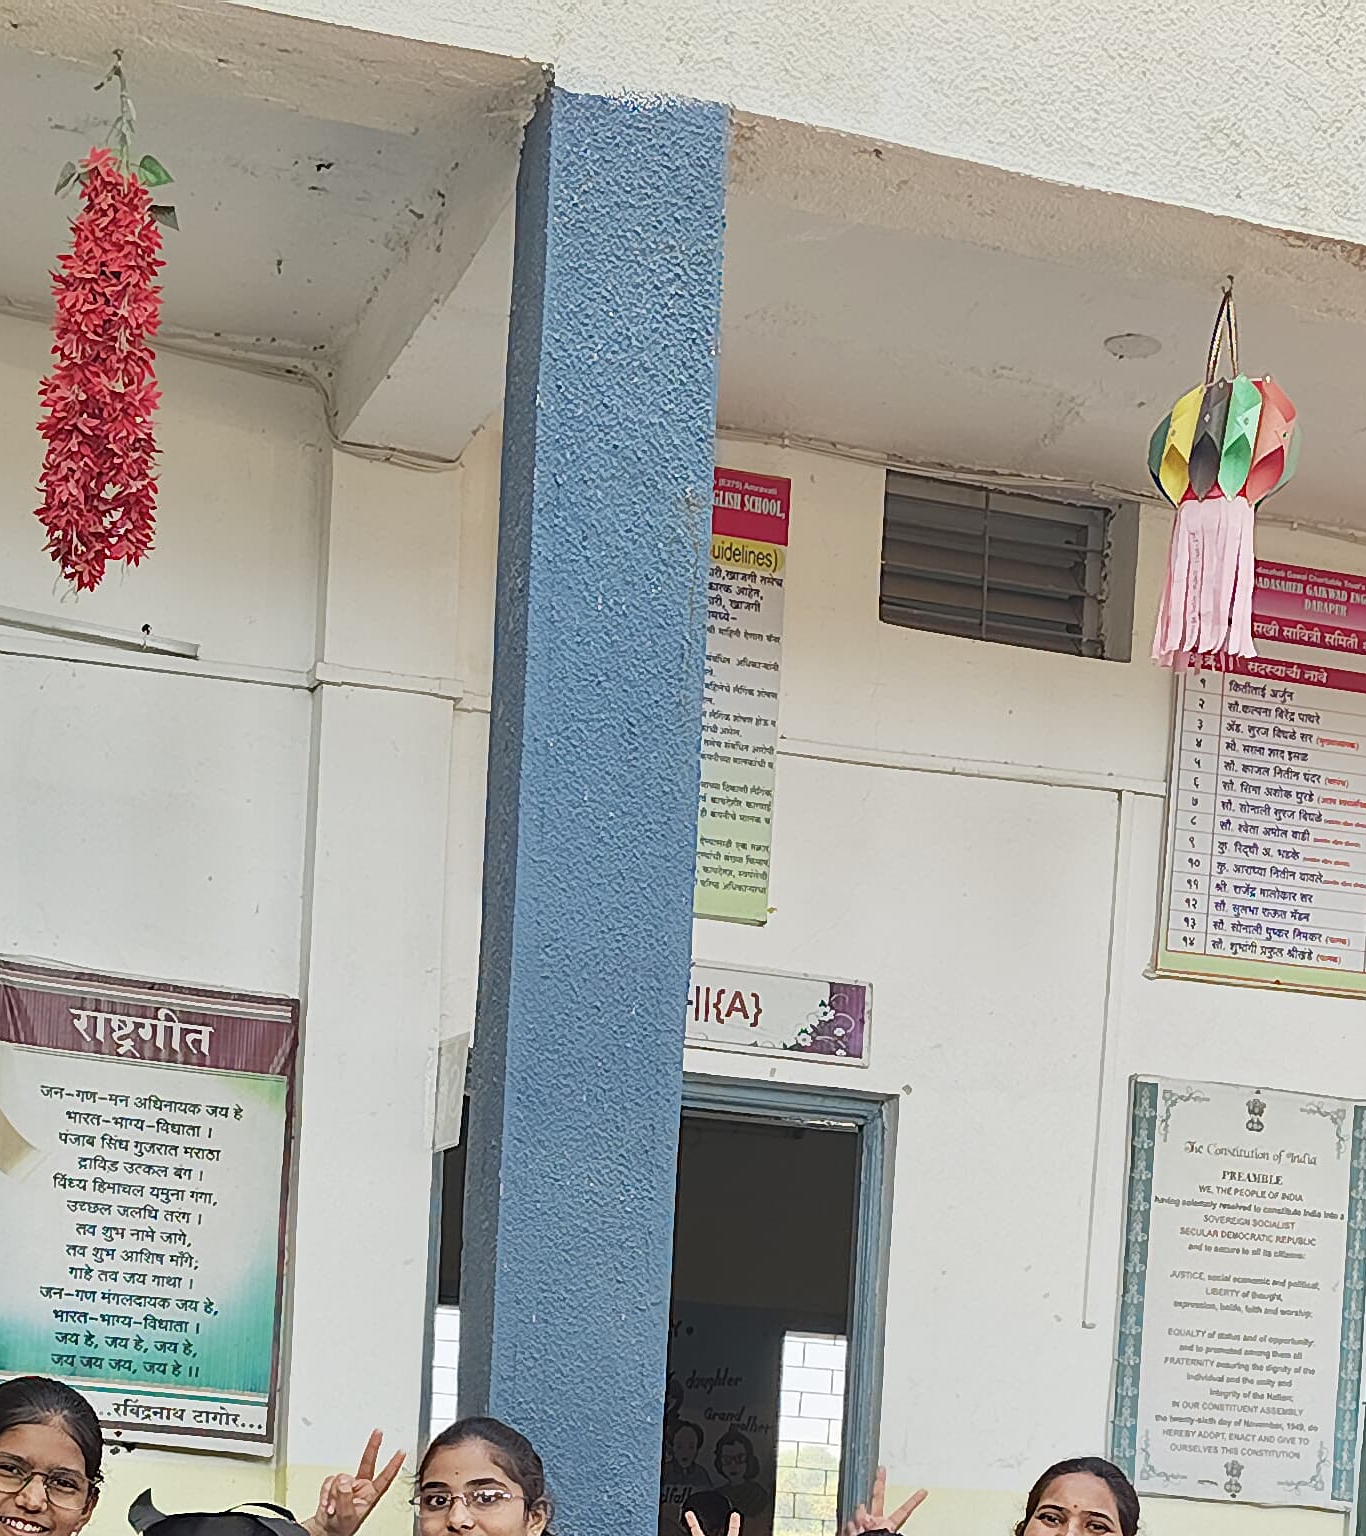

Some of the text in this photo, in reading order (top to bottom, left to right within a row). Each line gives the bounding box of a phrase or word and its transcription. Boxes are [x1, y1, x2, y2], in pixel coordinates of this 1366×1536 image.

[713, 489, 785, 519] GLISH SCHOOL,
[713, 541, 778, 573] uidelines)
[69, 1008, 215, 1057] राष्ट्रगीत
[205, 1105, 230, 1118] जय
[233, 1104, 243, 1121] हे
[134, 1140, 179, 1158] गुजरात
[183, 1146, 221, 1161] मराठा
[123, 1162, 169, 1178] उत्कल
[1221, 1170, 1283, 1185] PREAMBLE
[149, 1187, 186, 1204] यमुना
[76, 1223, 97, 1237] तव
[102, 1226, 126, 1242] शुभ
[130, 1225, 156, 1242] नामे
[66, 1244, 88, 1258] तव
[92, 1247, 116, 1264] शुभ
